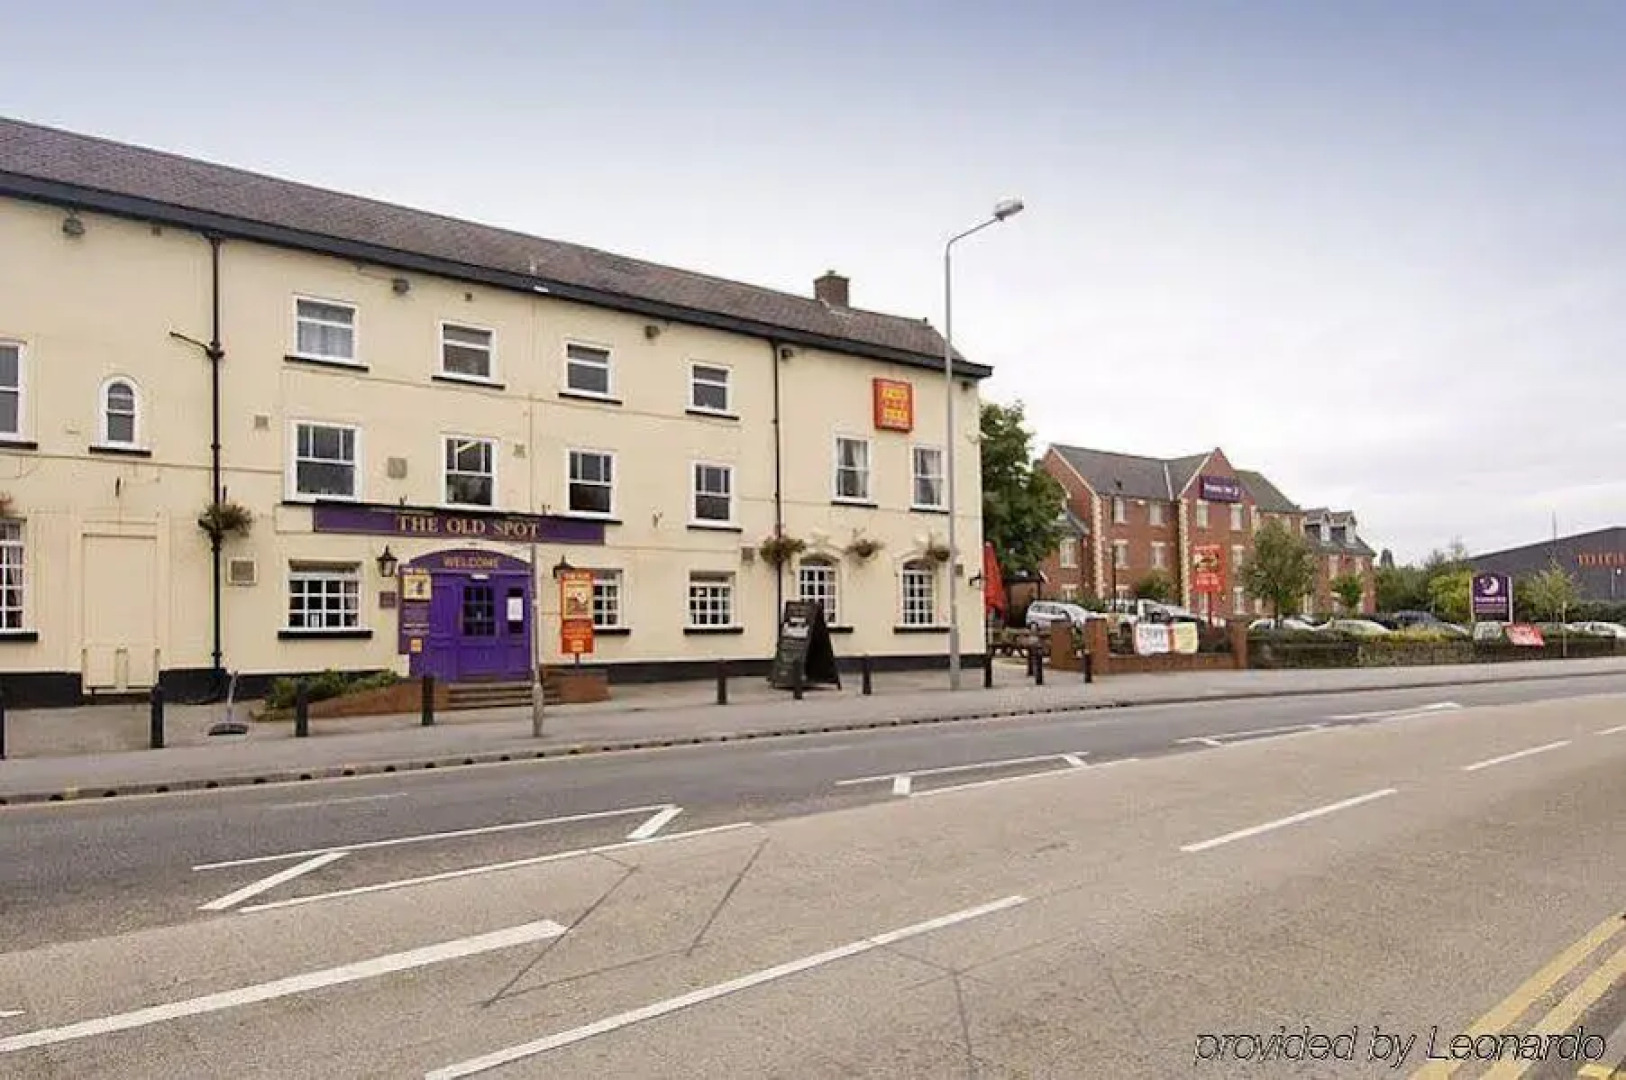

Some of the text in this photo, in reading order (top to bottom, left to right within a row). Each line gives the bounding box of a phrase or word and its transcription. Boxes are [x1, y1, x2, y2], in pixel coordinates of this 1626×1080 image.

[400, 515, 540, 539] THE OLD SPOT
